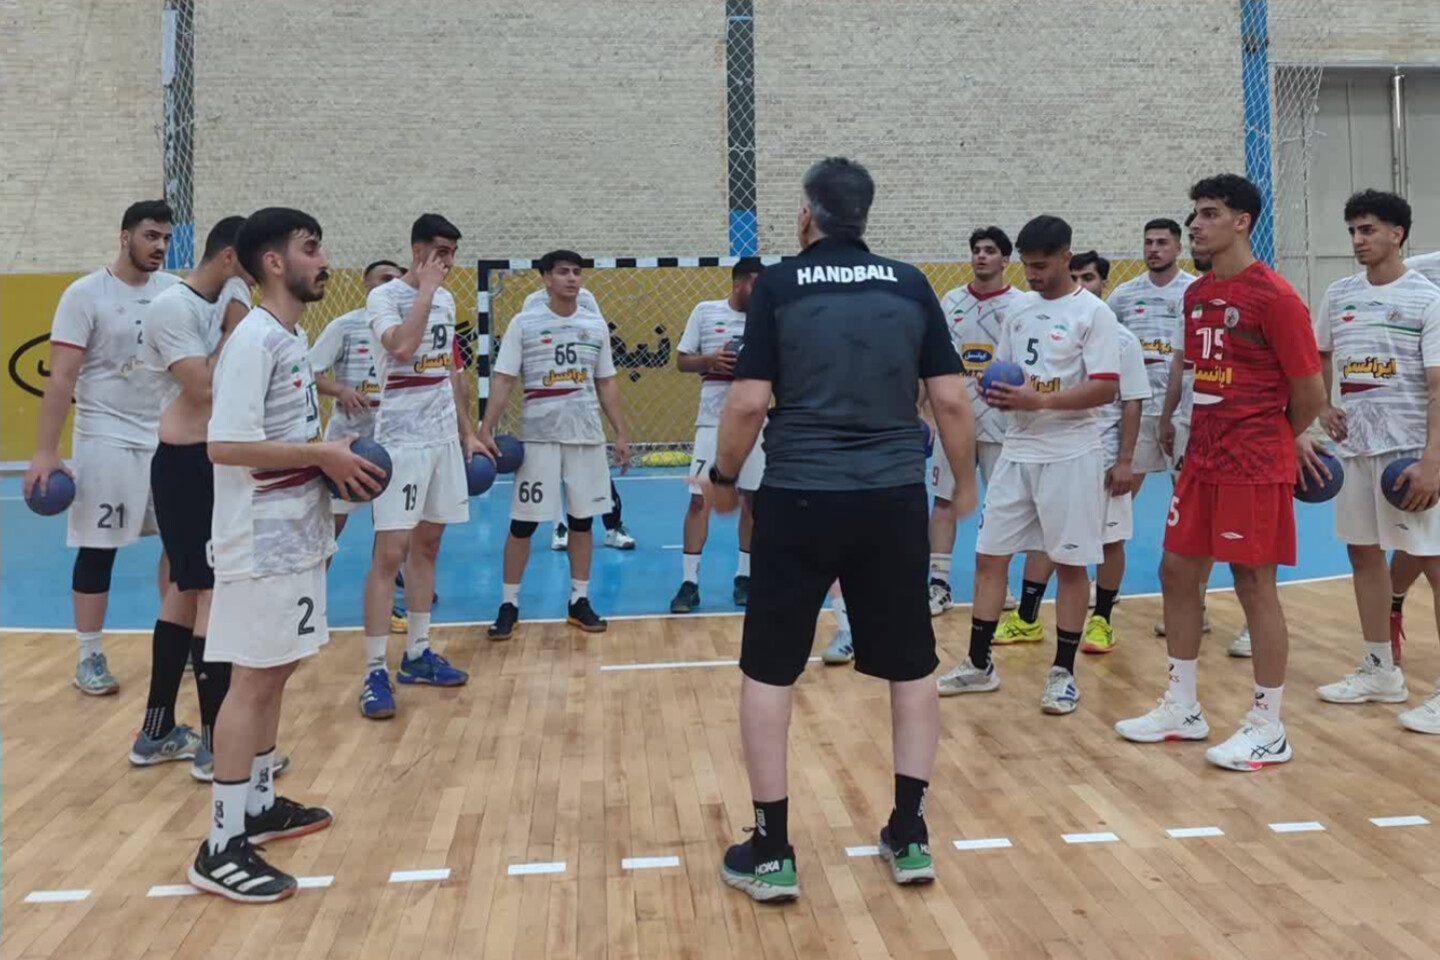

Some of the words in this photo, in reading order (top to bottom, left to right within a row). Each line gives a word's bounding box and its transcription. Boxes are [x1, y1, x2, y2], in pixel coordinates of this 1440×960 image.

[797, 264, 898, 286] HANDBALL
[431, 324, 447, 350] 19
[555, 343, 577, 365] 66
[1024, 338, 1039, 365] 5
[696, 459, 706, 478] 7
[402, 483, 417, 511] 19
[519, 481, 543, 504] 66
[97, 502, 125, 528] 21
[1167, 496, 1180, 527] 5
[297, 596, 315, 635] 2
[755, 860, 780, 876] HOKA
